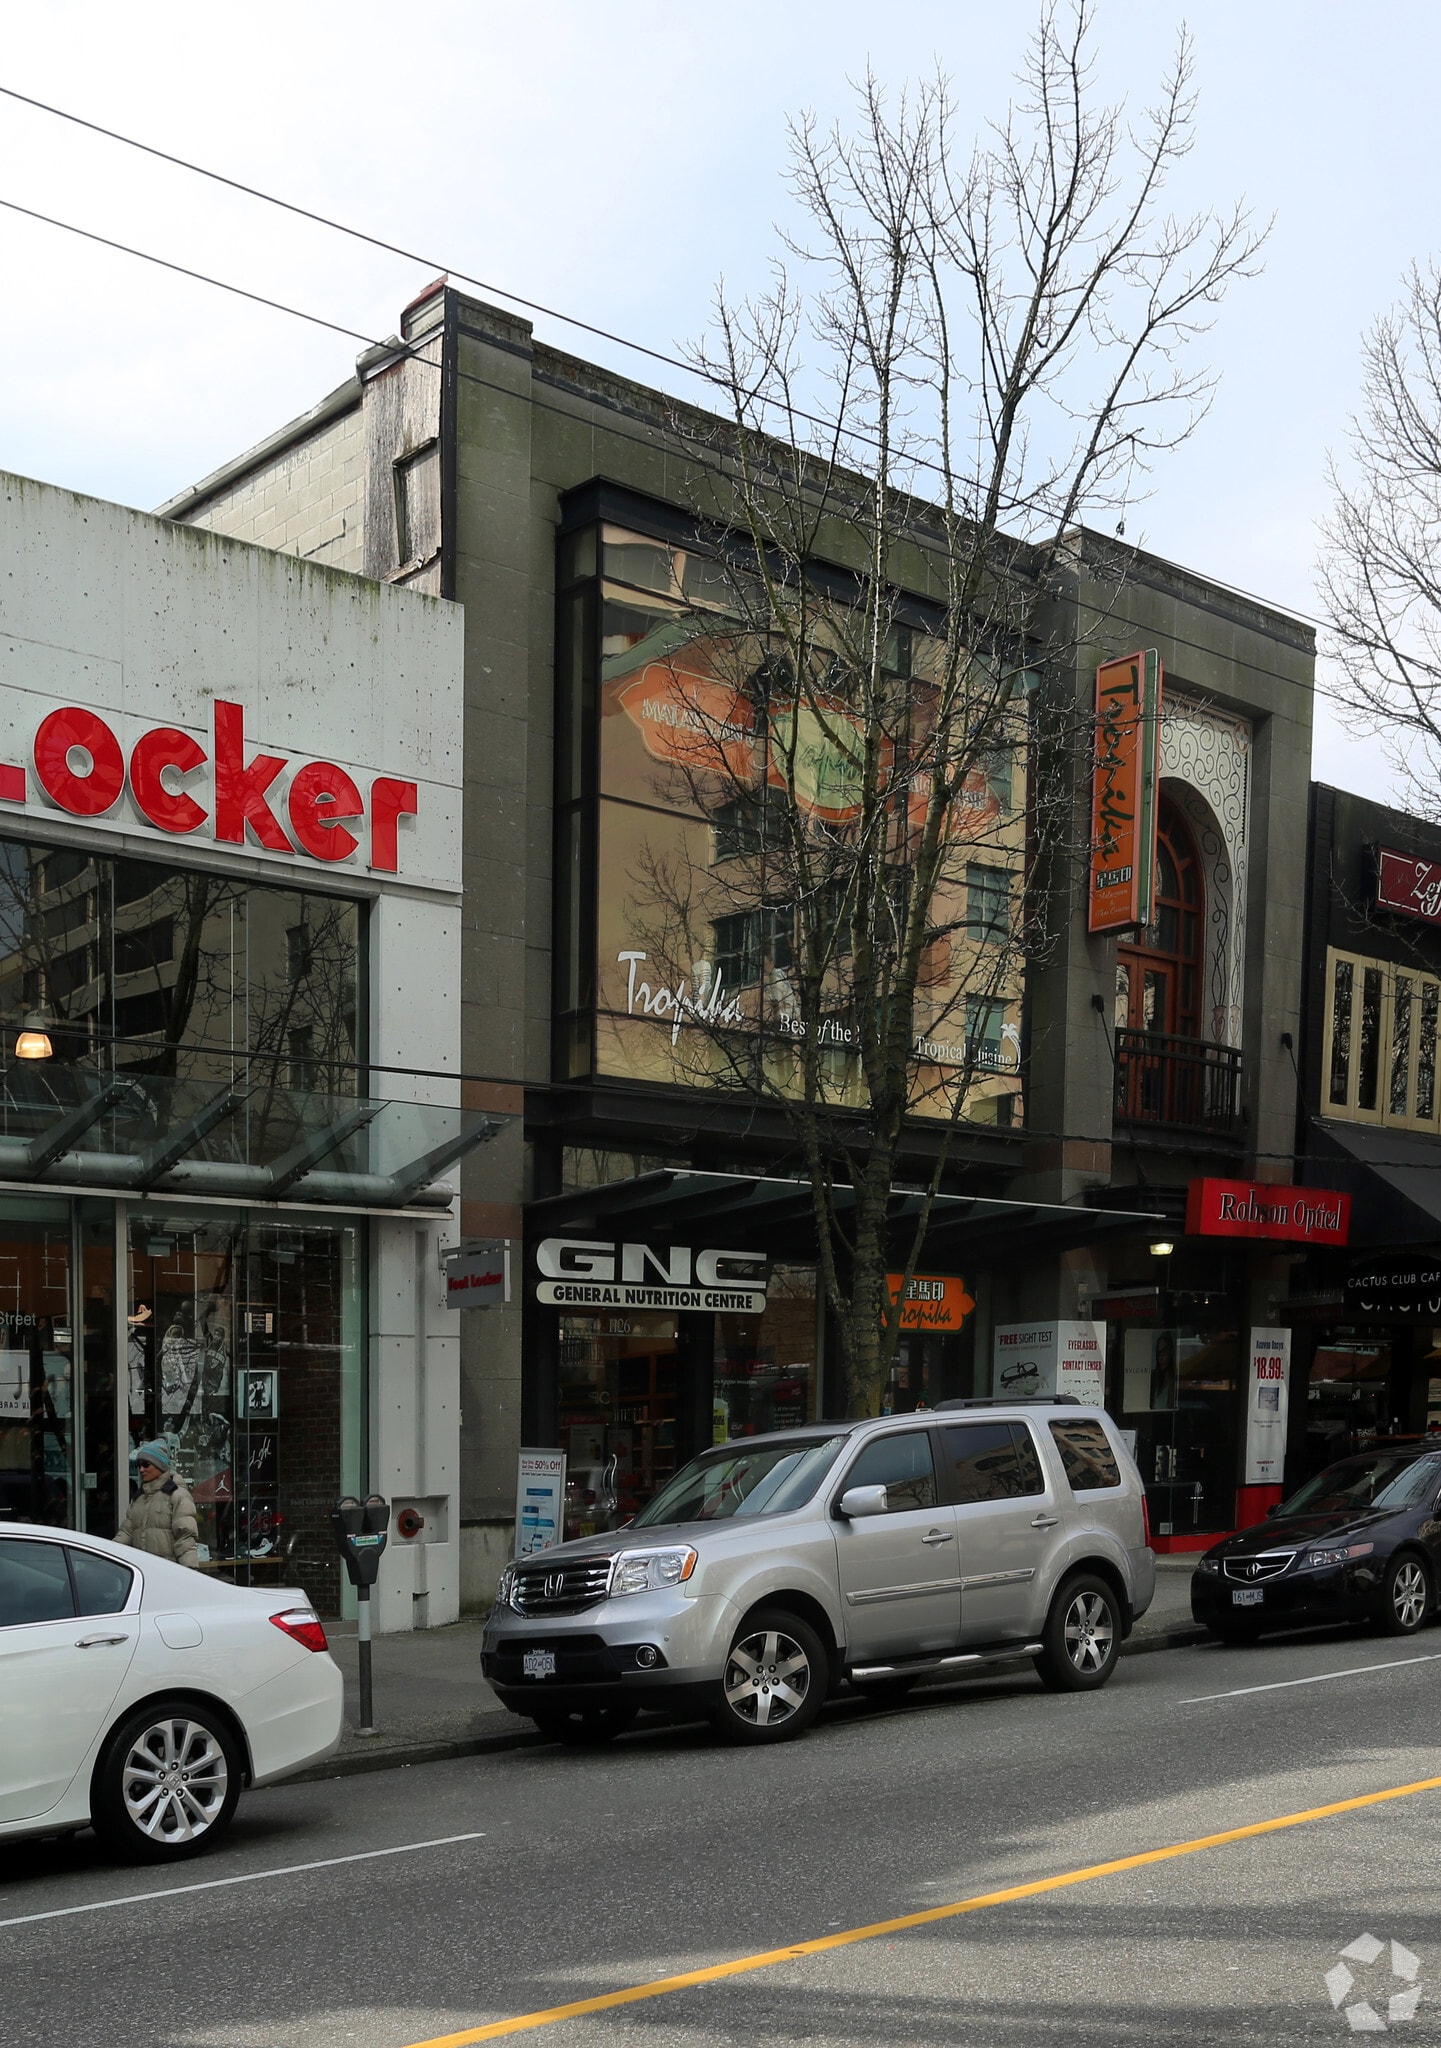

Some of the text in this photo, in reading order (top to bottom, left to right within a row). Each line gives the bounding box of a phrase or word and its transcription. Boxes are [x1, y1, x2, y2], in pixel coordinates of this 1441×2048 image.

[0, 699, 418, 874] ocker
[617, 950, 744, 1046] Tropika
[779, 1013, 808, 1036] Bes
[831, 1020, 852, 1043] the
[915, 1035, 967, 1063] Tropical
[1218, 1189, 1342, 1235] Robson Optical
[536, 1237, 767, 1290] GNC
[448, 1271, 503, 1291] Foot Locker
[1347, 1271, 1441, 1289] CACTUS CLUB CAF
[553, 1285, 752, 1309] GENERAL NUTRITION CENTRE
[0, 1311, 37, 1326] Street
[1018, 1332, 1037, 1344] SIGHT
[1038, 1331, 1053, 1342] TEST
[1068, 1340, 1097, 1350] EYEGLASSES
[1062, 1361, 1102, 1371] CONTACT LENSES
[535, 1460, 561, 1470] 50% Off
